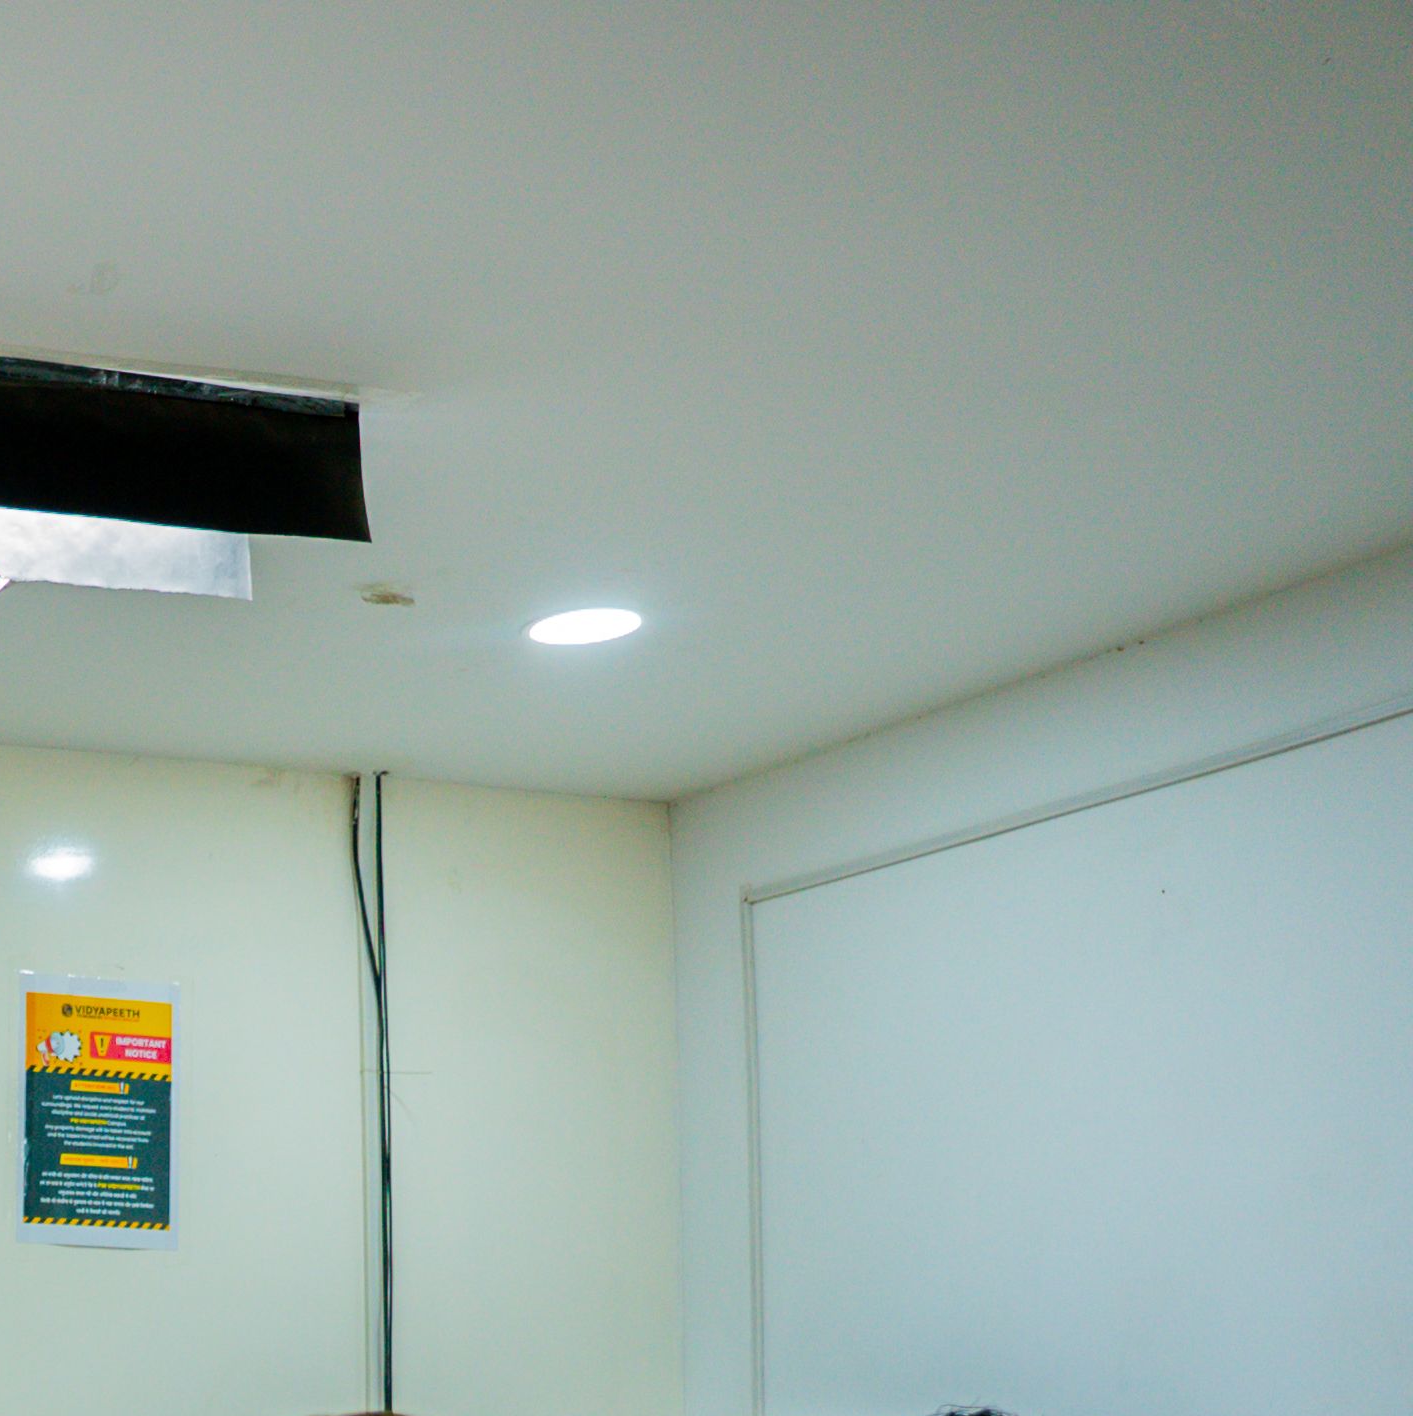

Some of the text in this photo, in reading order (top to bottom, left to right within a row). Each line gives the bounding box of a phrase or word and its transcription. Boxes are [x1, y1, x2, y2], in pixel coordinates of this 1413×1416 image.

[75, 1005, 140, 1019] VIDYAPEETH
[116, 1037, 167, 1049] IMPORTANT
[125, 1048, 158, 1060] NOTICE
